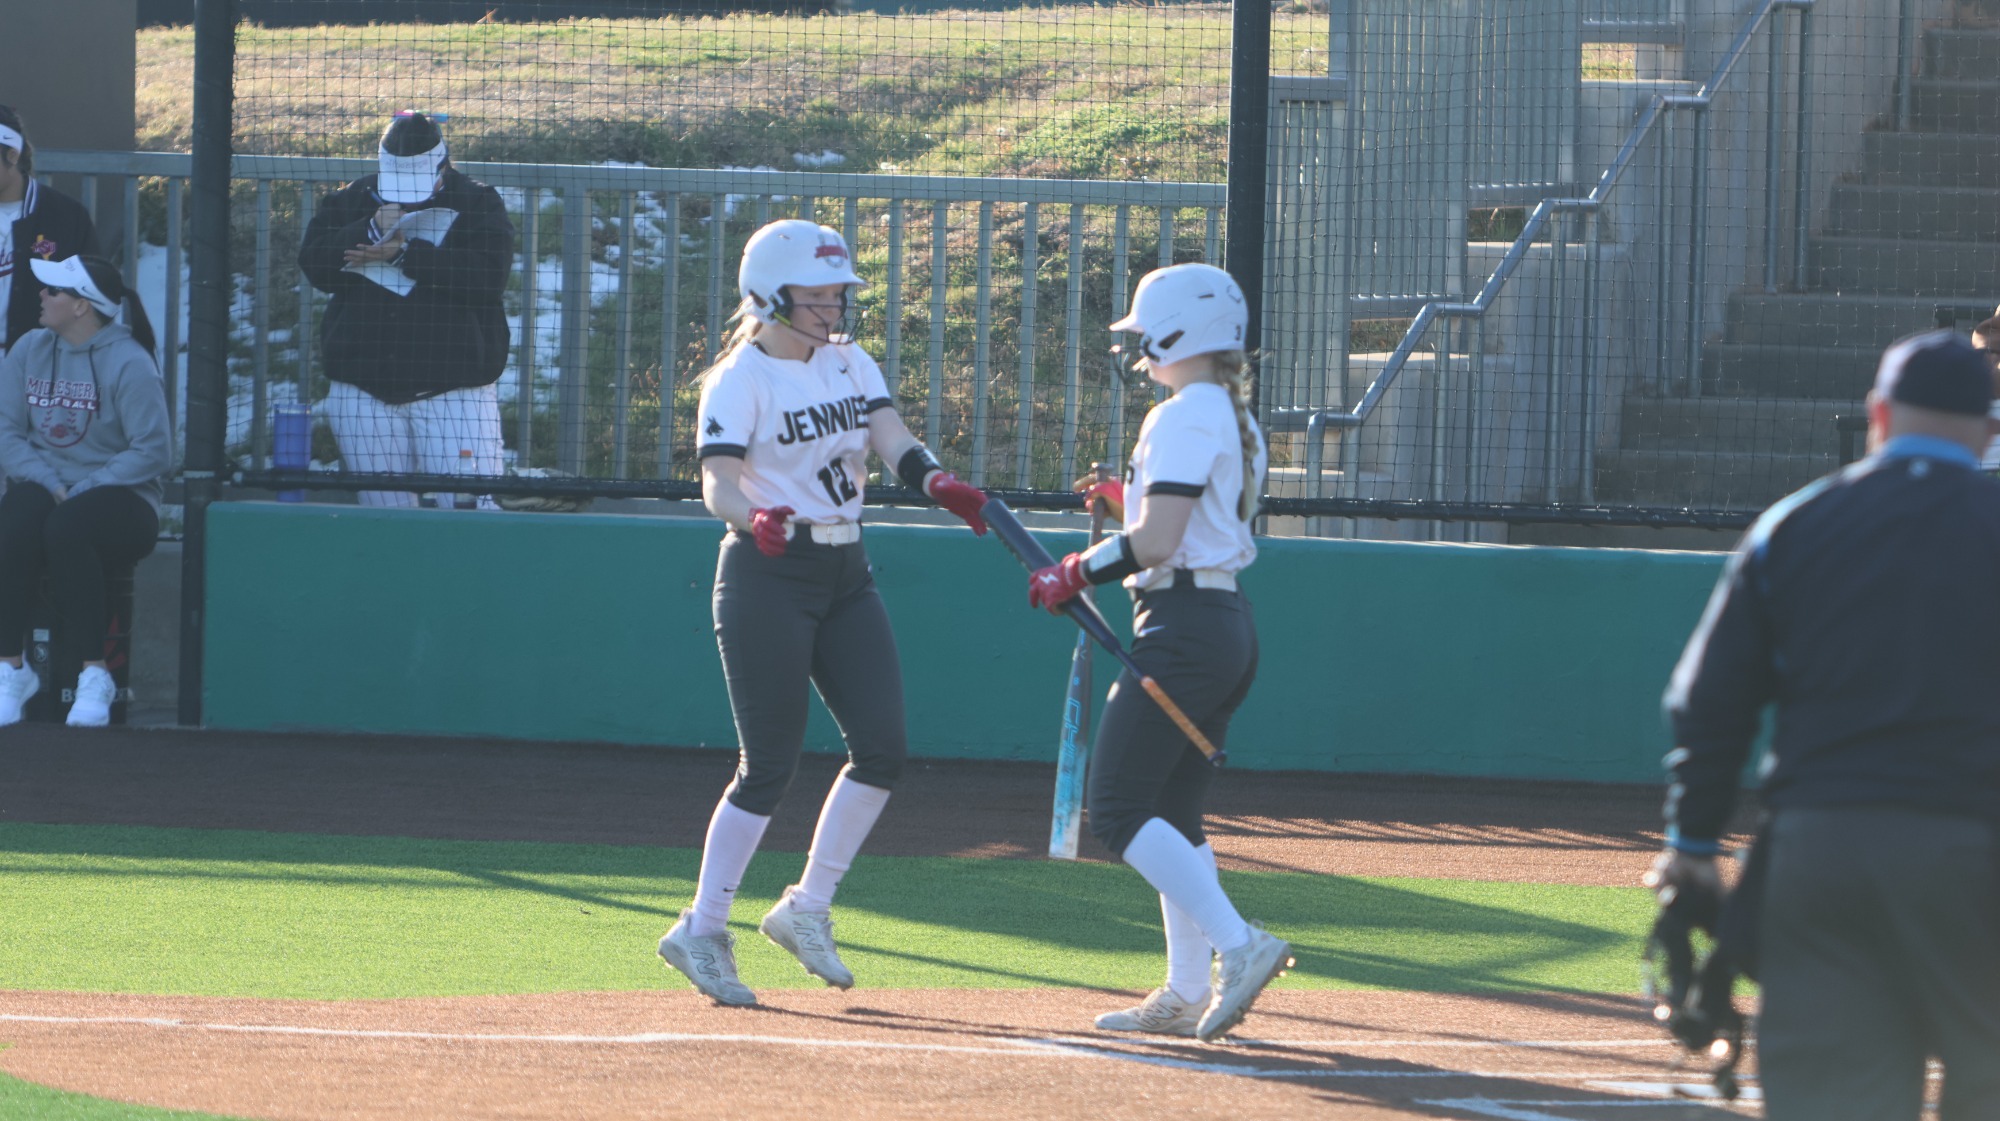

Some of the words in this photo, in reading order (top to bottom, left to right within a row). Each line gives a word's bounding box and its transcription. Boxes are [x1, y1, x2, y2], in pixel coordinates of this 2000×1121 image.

[26, 377, 98, 400] MIDESTER
[777, 395, 869, 444] JENNIE
[817, 457, 857, 507] 12
